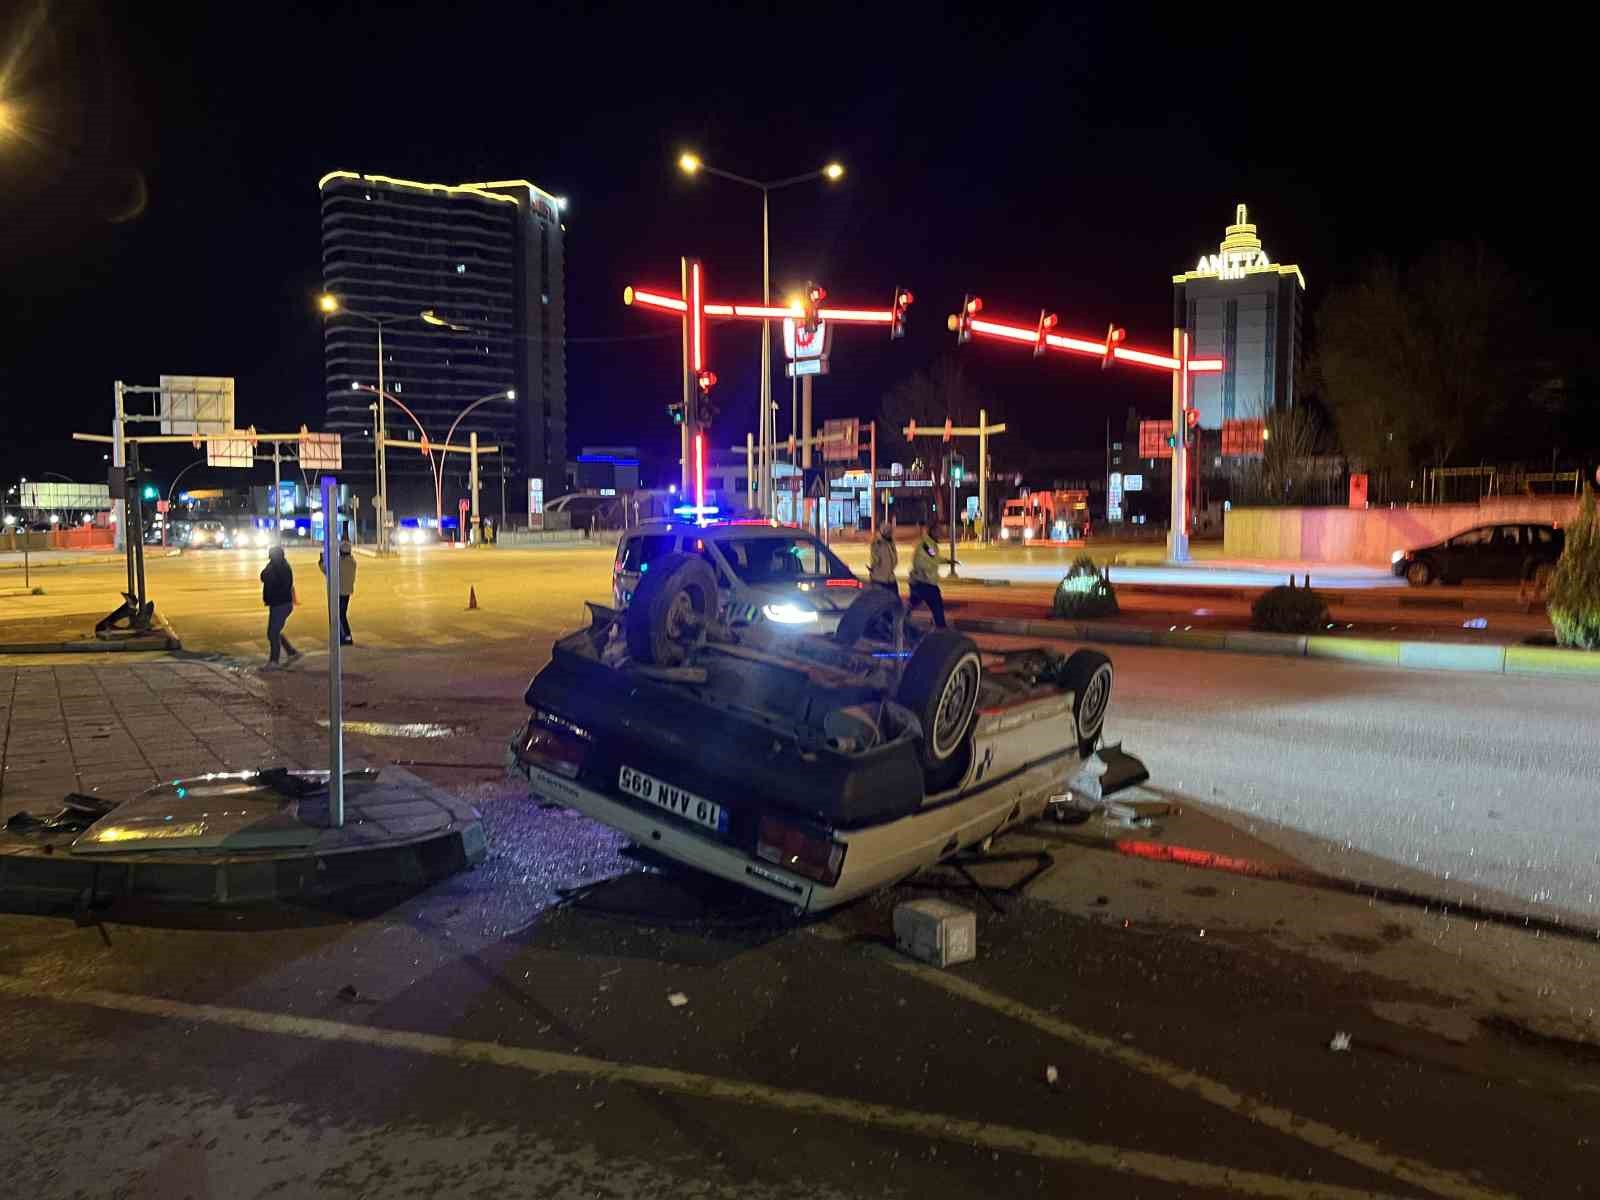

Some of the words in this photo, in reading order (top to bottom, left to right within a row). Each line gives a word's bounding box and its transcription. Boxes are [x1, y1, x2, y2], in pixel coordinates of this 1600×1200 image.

[621, 767, 653, 797] 695
[658, 784, 690, 814] AAN
[696, 800, 717, 825] 19
